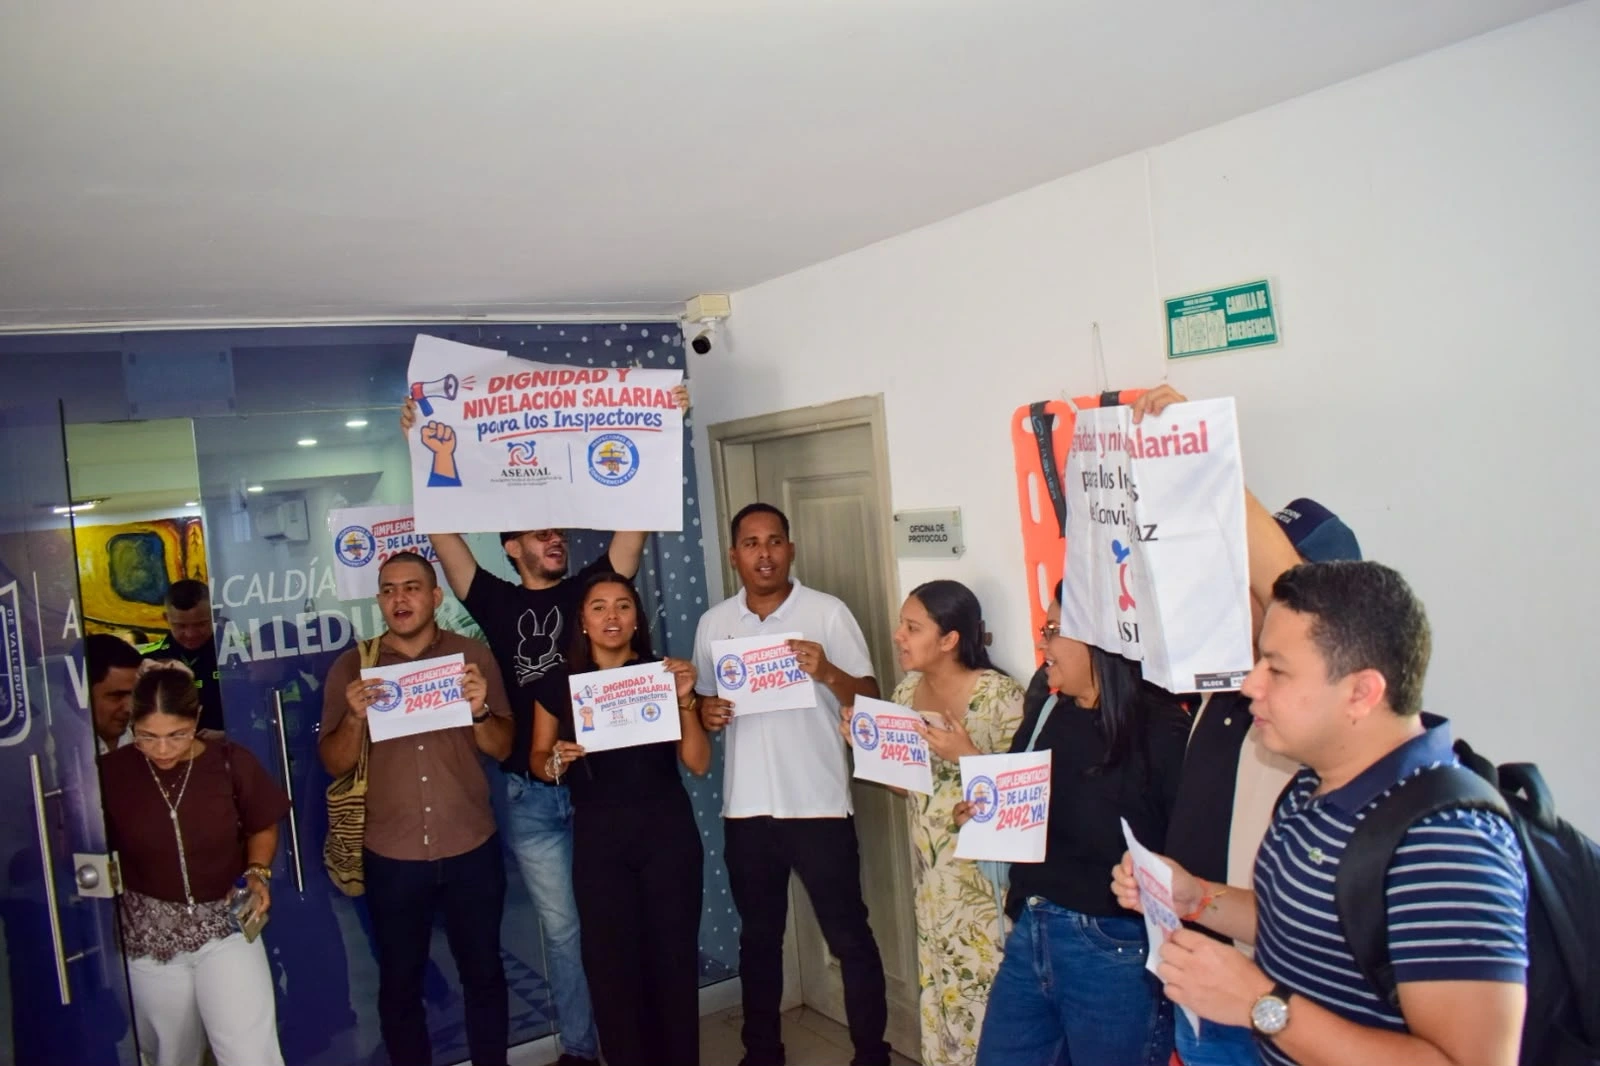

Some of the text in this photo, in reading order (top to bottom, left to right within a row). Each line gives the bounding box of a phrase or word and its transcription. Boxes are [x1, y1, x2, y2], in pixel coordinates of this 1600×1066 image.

[488, 368, 633, 394] DIGNIDAD Y
[462, 386, 677, 420] NIVELACIÓN SALARIAL
[477, 408, 663, 442] para los Inspectores
[1099, 431, 1106, 458] y
[501, 467, 551, 478] ASEAVAL
[1099, 464, 1115, 489] los
[909, 523, 945, 533] OFICINA DE
[387, 536, 399, 549] DE
[401, 535, 414, 546] LA
[908, 534, 948, 543] PROTOCOLO
[62, 598, 82, 639] A
[7, 609, 25, 718] DE VALLEDUPAR
[755, 656, 796, 674] DE LA LEY
[412, 677, 455, 695] DE LA LEY
[602, 675, 654, 694] DIGNIDAD Y
[749, 670, 786, 693] 2492
[785, 668, 807, 682] YA!
[405, 690, 442, 714] 2492
[595, 683, 672, 704] NIVELACIÓN SALARIAL
[600, 692, 668, 712] para los Inspectores
[886, 731, 919, 744] DE LA LEY
[880, 743, 926, 763] 2492 YA!
[1007, 786, 1042, 805] DE LA LEY
[995, 802, 1046, 831] 2492 YA!
